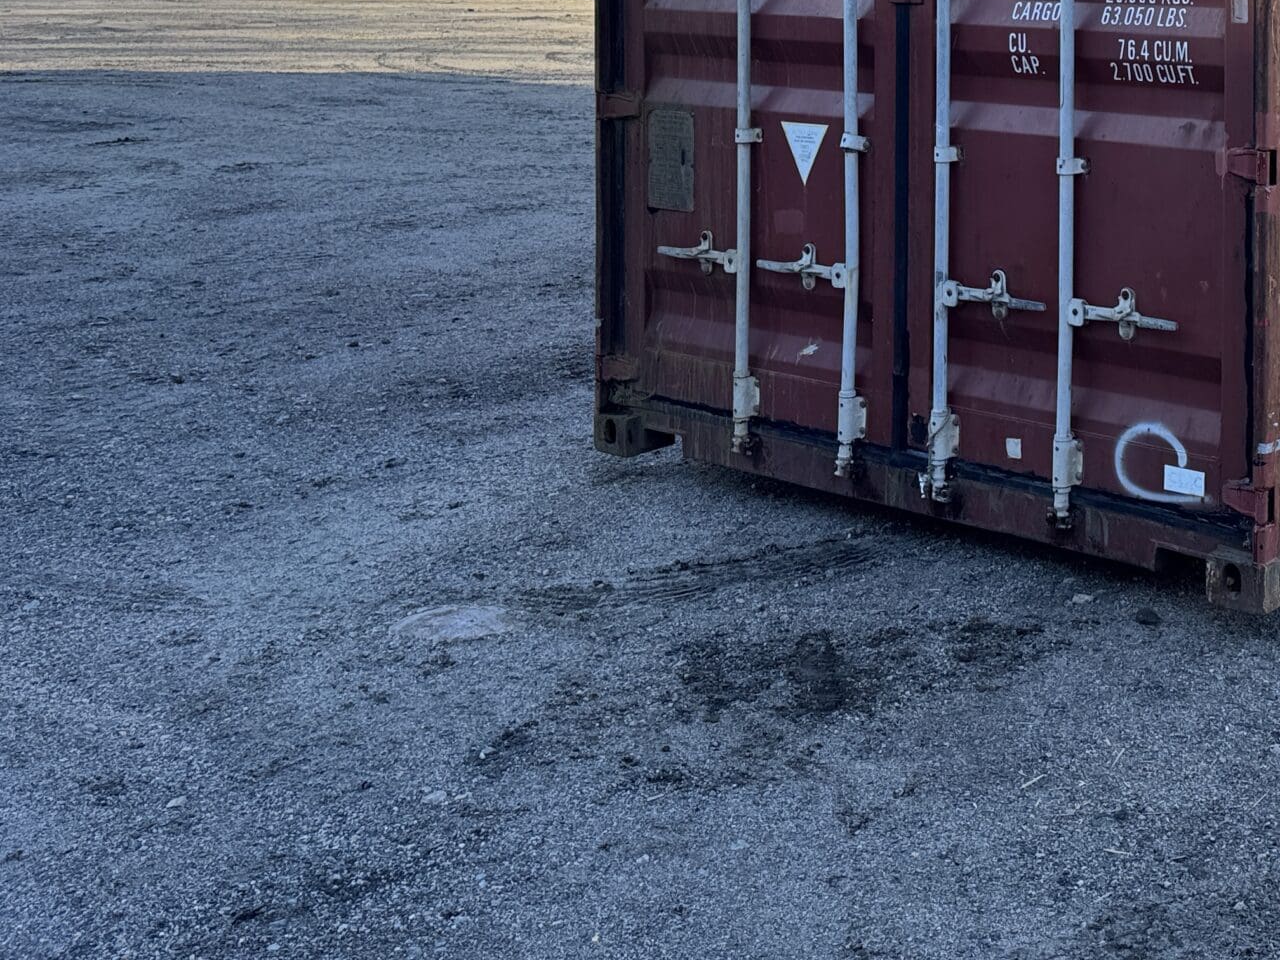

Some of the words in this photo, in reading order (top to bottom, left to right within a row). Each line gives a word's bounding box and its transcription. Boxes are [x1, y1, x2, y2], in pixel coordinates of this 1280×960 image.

[1012, 2, 1061, 21] CARGO
[1101, 6, 1155, 26] 63.050
[1157, 7, 1188, 28] LBS.
[1009, 32, 1032, 54] CU.
[1118, 38, 1150, 61] 76.4
[1154, 40, 1193, 63] CU.M.
[1010, 55, 1046, 75] CAP.
[1110, 62, 1154, 82] 2.700
[1156, 64, 1200, 85] CU.FT.
